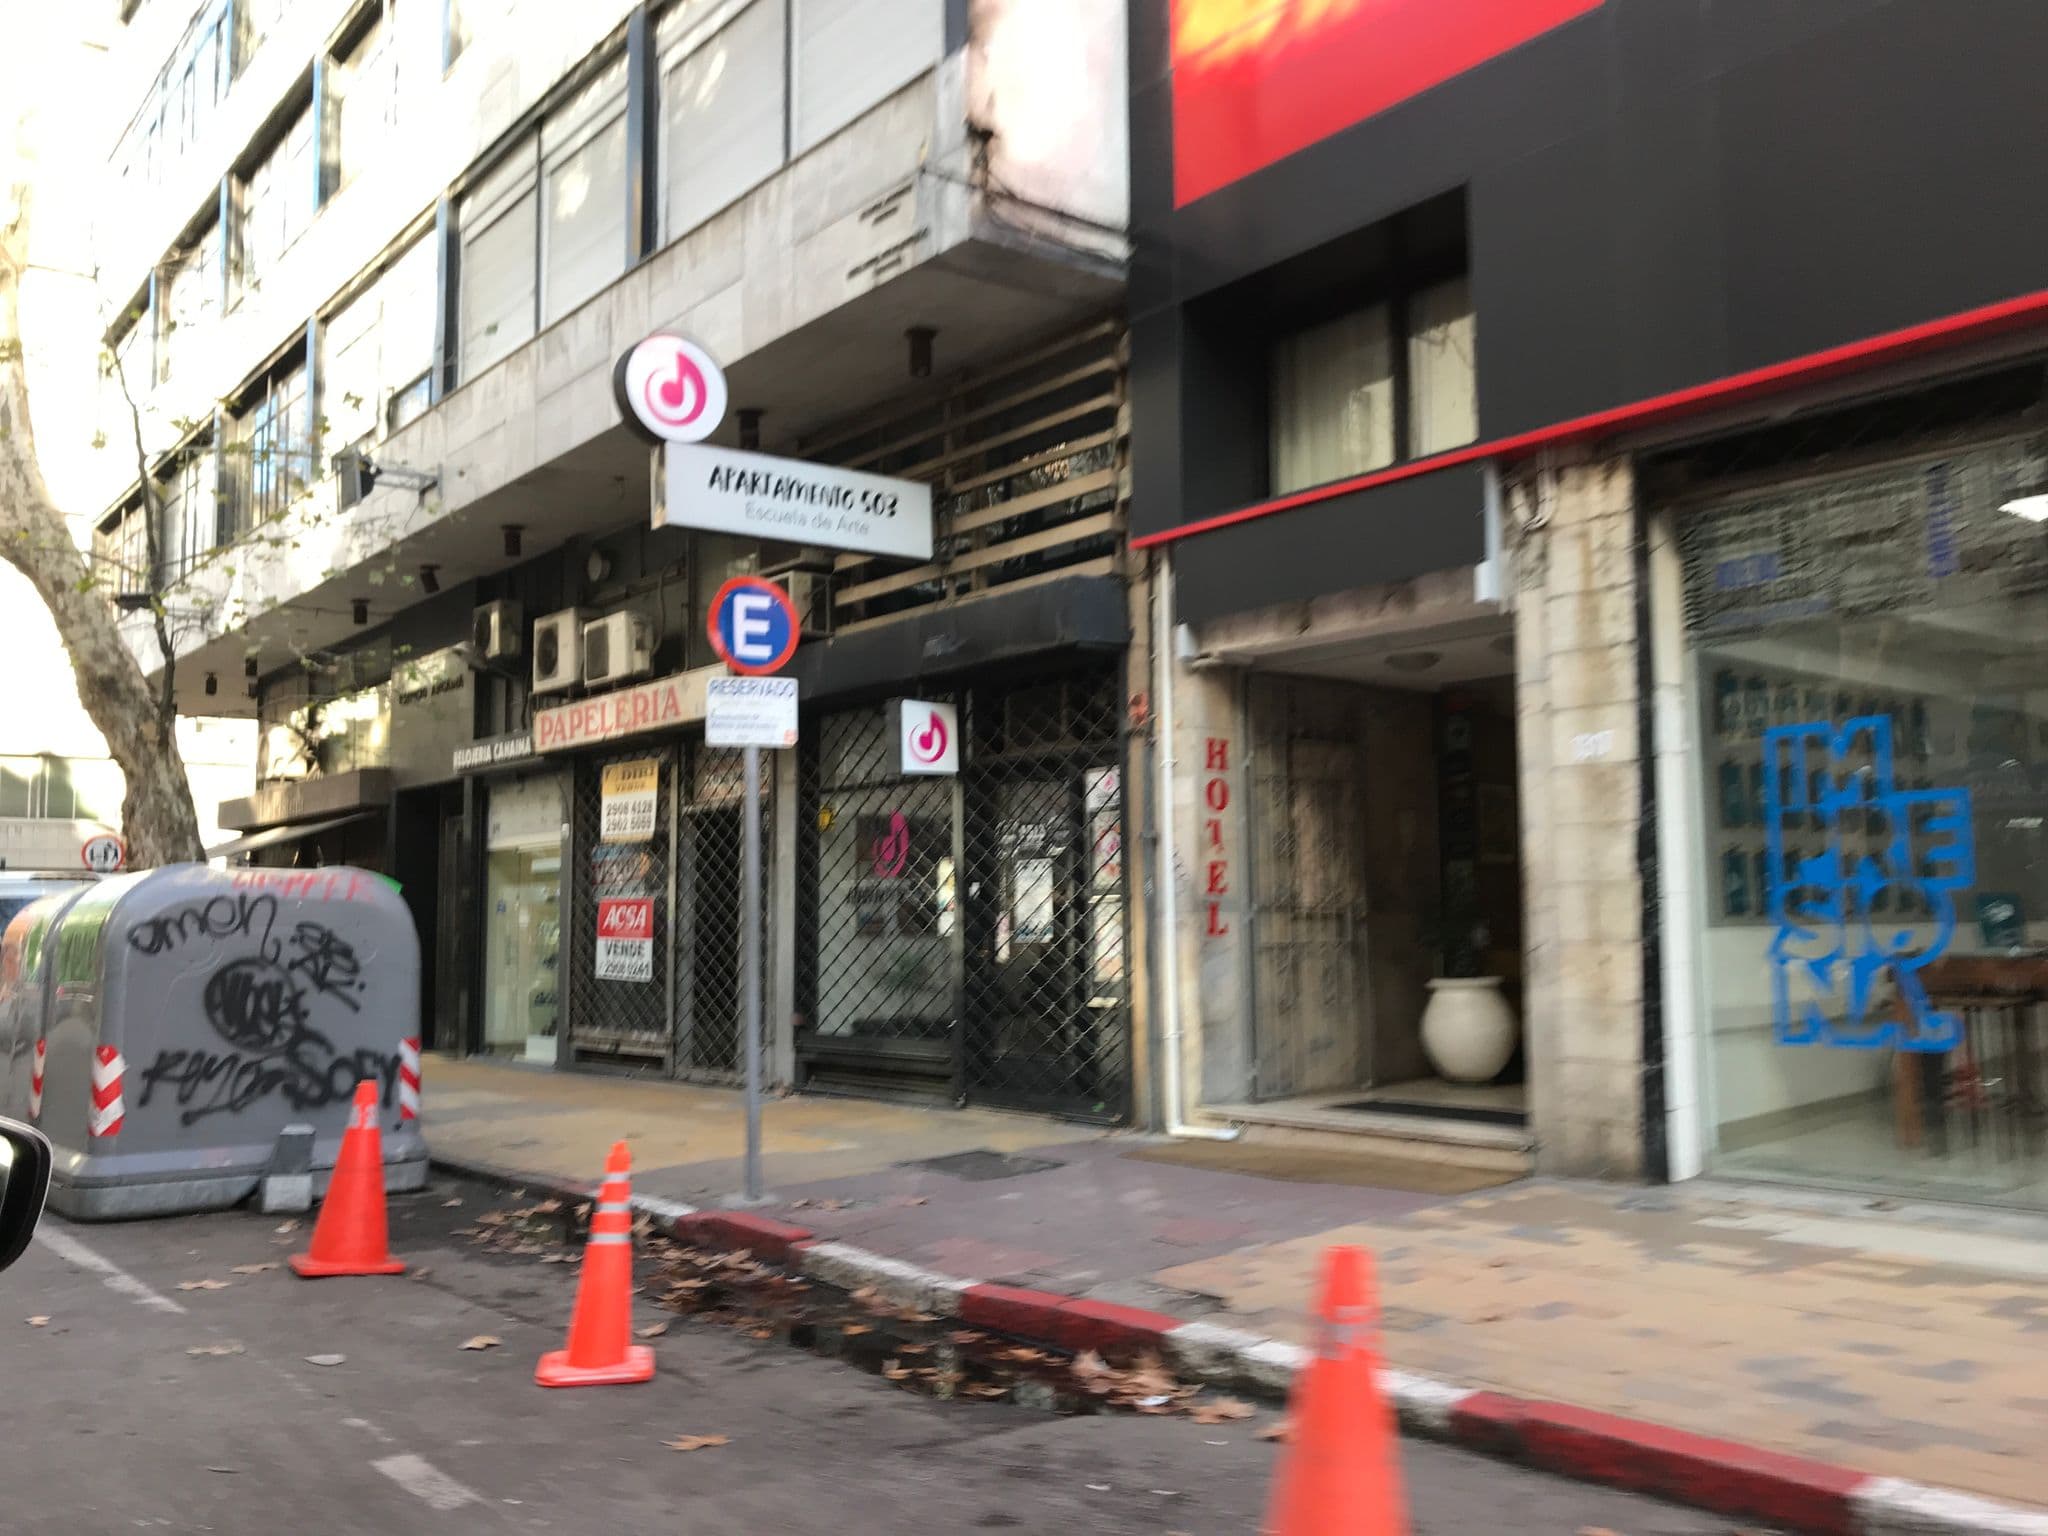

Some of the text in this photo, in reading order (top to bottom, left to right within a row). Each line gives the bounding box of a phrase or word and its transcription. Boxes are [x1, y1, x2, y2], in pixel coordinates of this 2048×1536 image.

[707, 464, 899, 519] APARTAMENTO 503
[745, 500, 870, 537] Escuela de Arte
[733, 593, 773, 660] E
[540, 686, 682, 747] PAPELERIA
[1205, 737, 1229, 938] HOTEL
[602, 904, 648, 931] ACSA
[605, 940, 646, 958] VENDE
